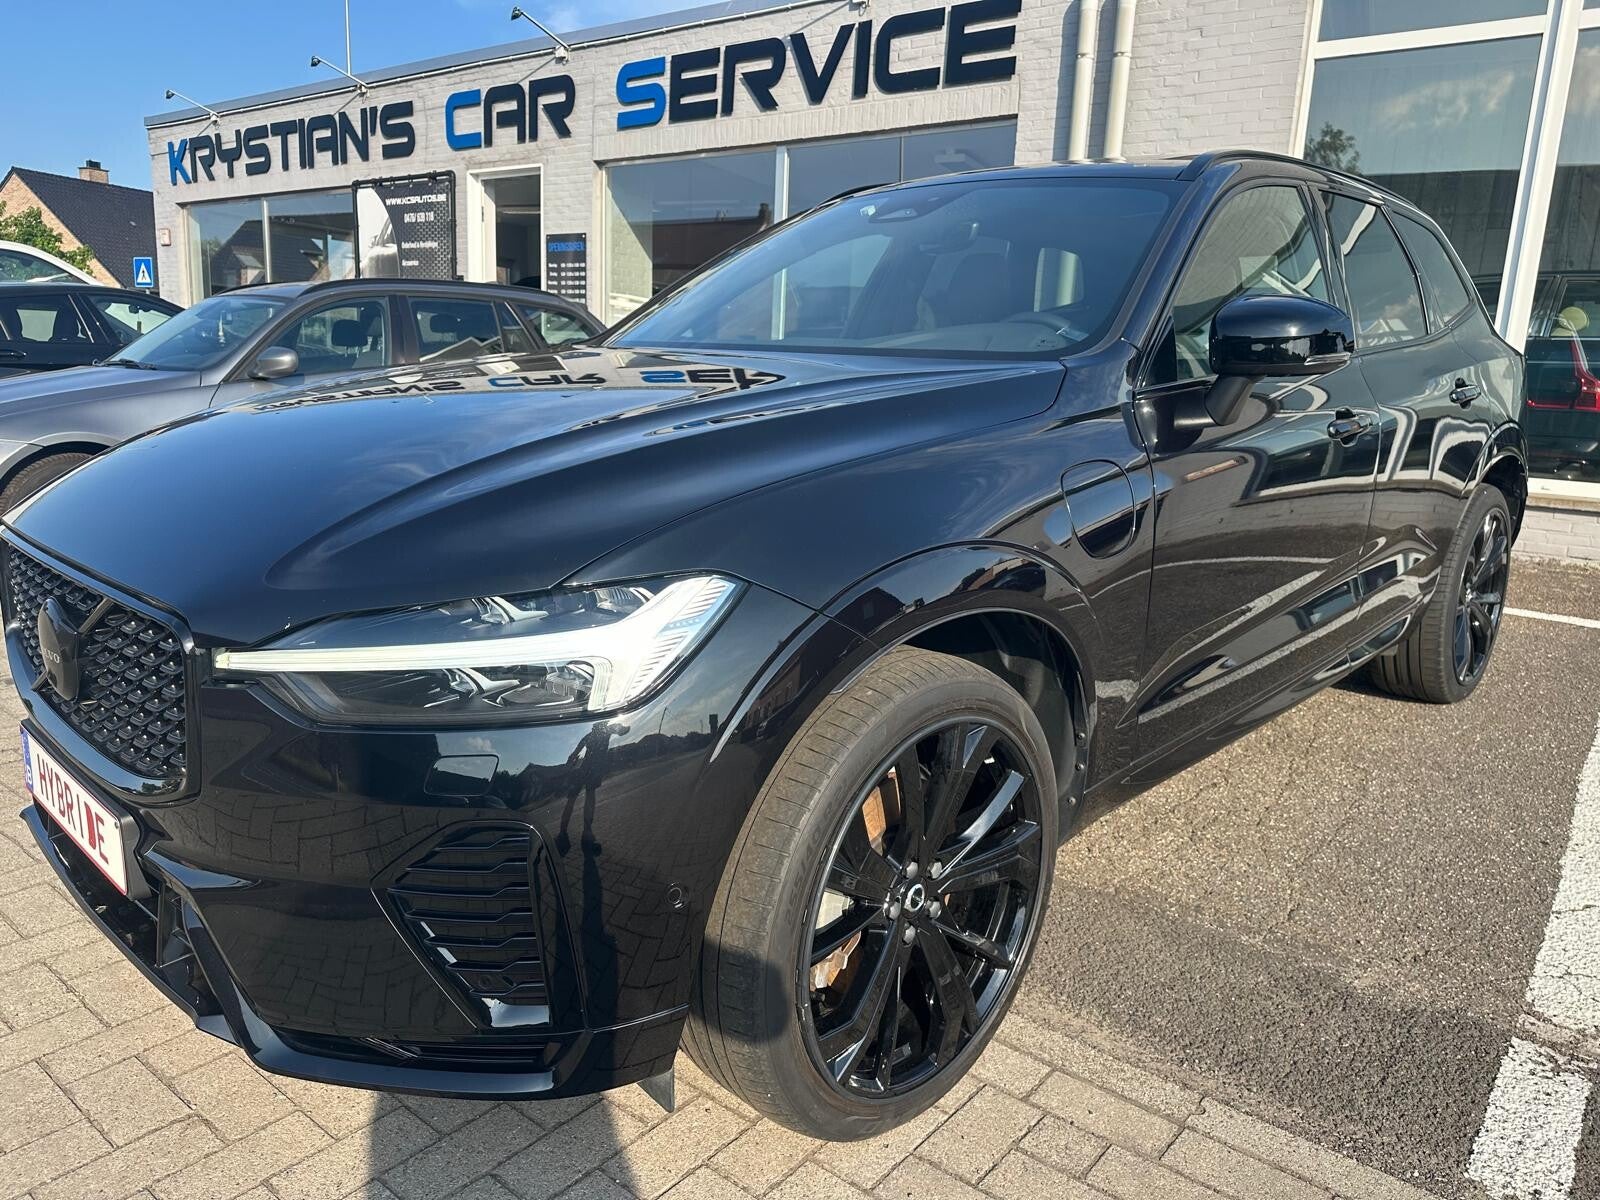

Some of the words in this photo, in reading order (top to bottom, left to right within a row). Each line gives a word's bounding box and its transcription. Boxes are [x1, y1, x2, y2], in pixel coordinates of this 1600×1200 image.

[167, 101, 416, 186] KRYSTIAN'S
[445, 74, 576, 151] CAR
[616, 0, 1022, 131] SERVICE
[37, 753, 109, 865] HYBRIDE
